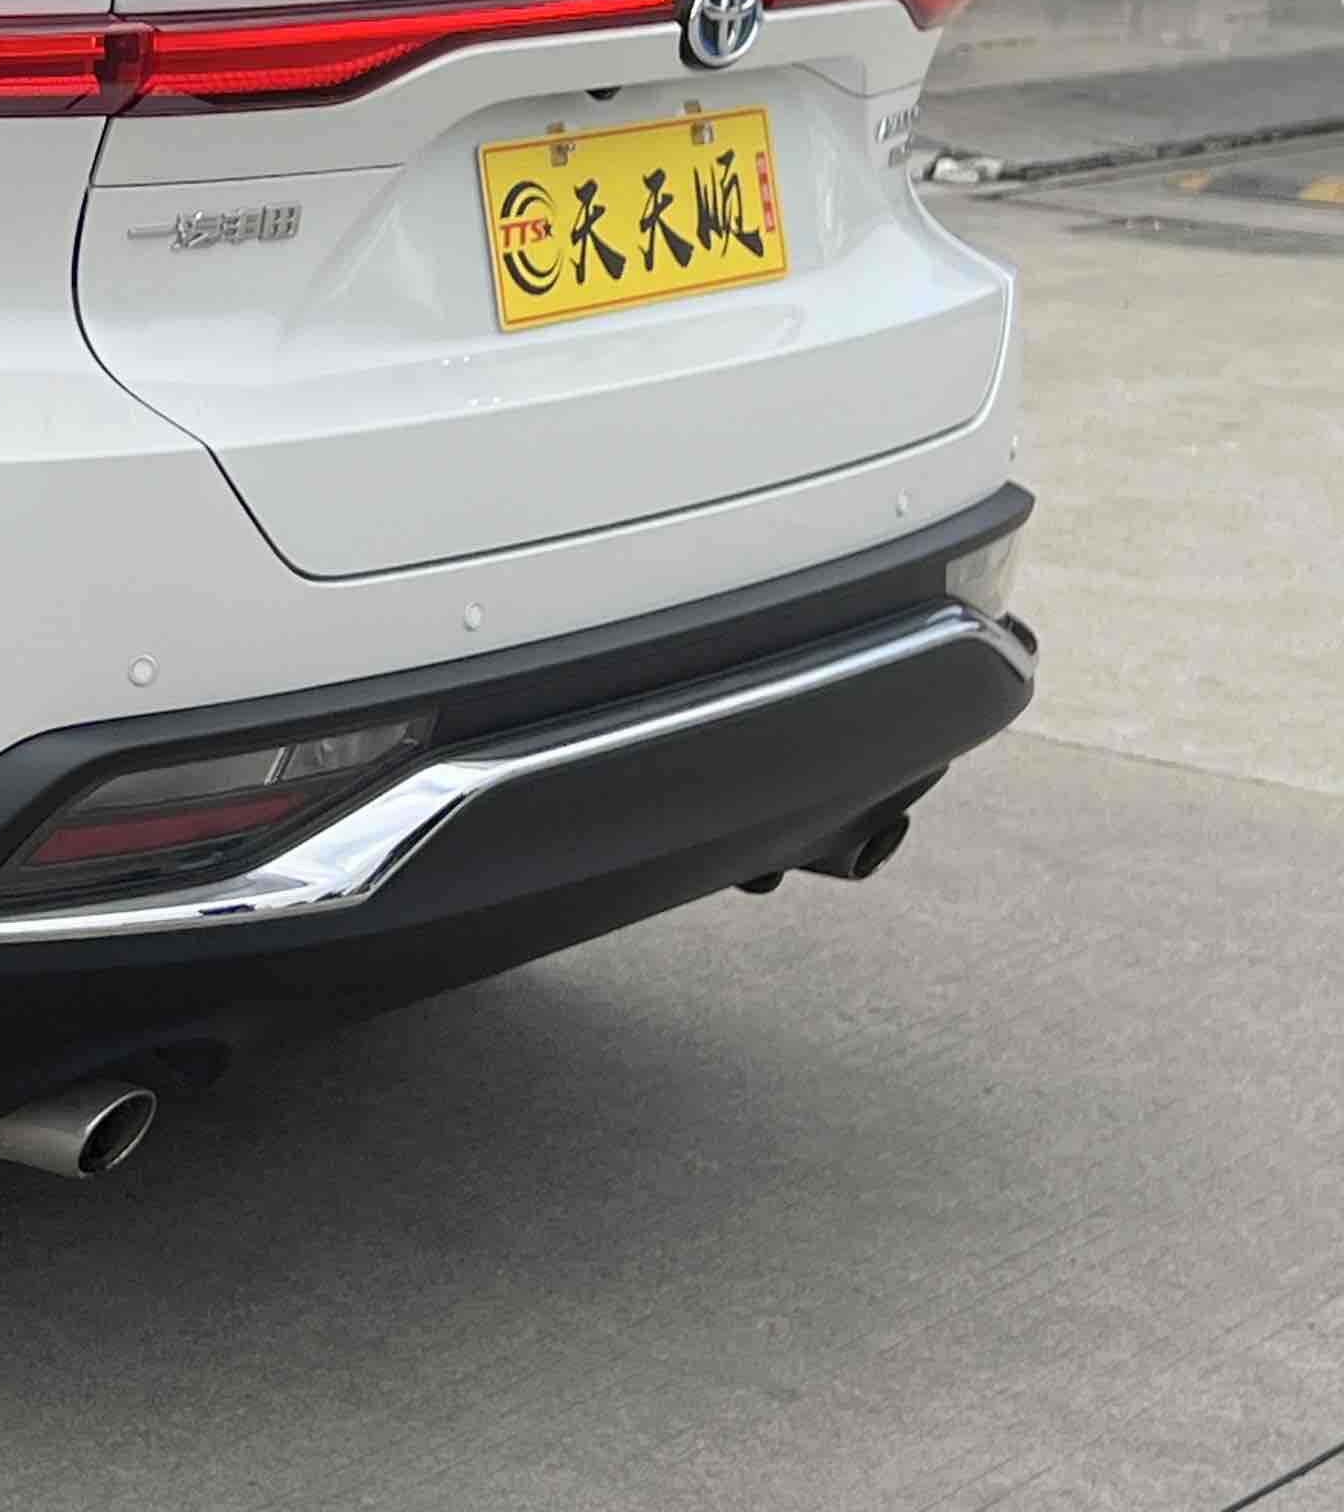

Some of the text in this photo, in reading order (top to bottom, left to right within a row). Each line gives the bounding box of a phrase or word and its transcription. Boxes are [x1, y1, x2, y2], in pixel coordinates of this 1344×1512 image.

[500, 218, 546, 249] TTS
[570, 148, 765, 285] 天天顺
